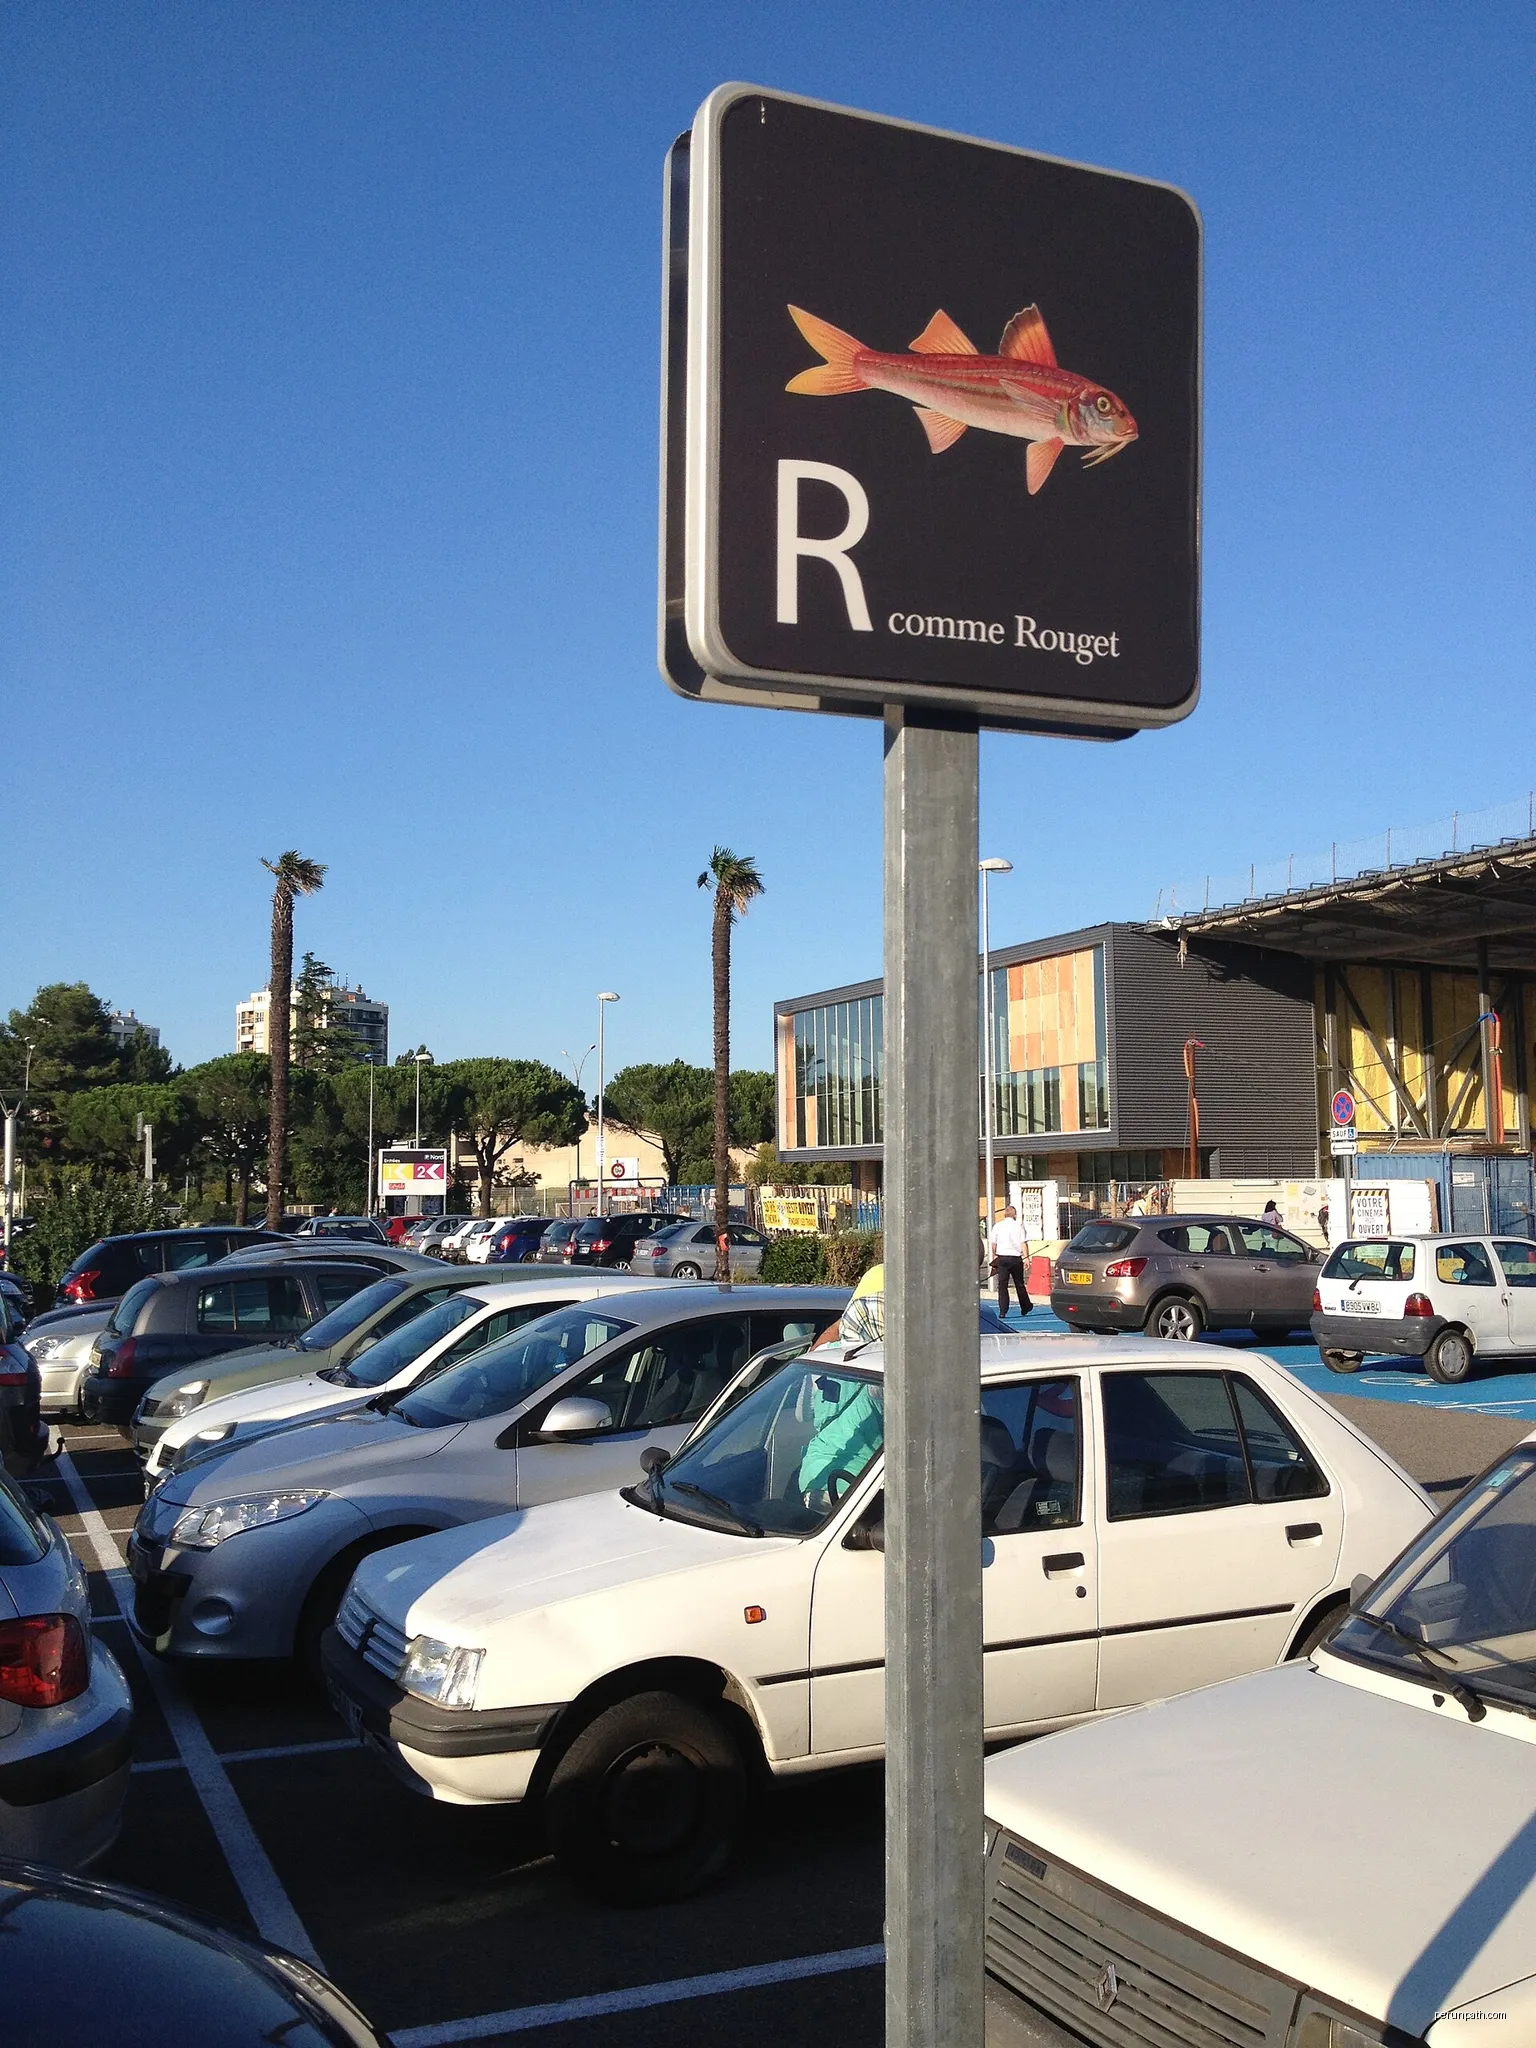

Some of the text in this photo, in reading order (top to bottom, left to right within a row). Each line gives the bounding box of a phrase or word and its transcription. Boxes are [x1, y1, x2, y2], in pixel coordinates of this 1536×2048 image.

[777, 459, 1120, 666] R comme Rouget
[1332, 1130, 1347, 1138] SAUF
[416, 1165, 426, 1178] 2
[1356, 1198, 1383, 1208] VOTRE
[1358, 1224, 1384, 1234] OUVERT
